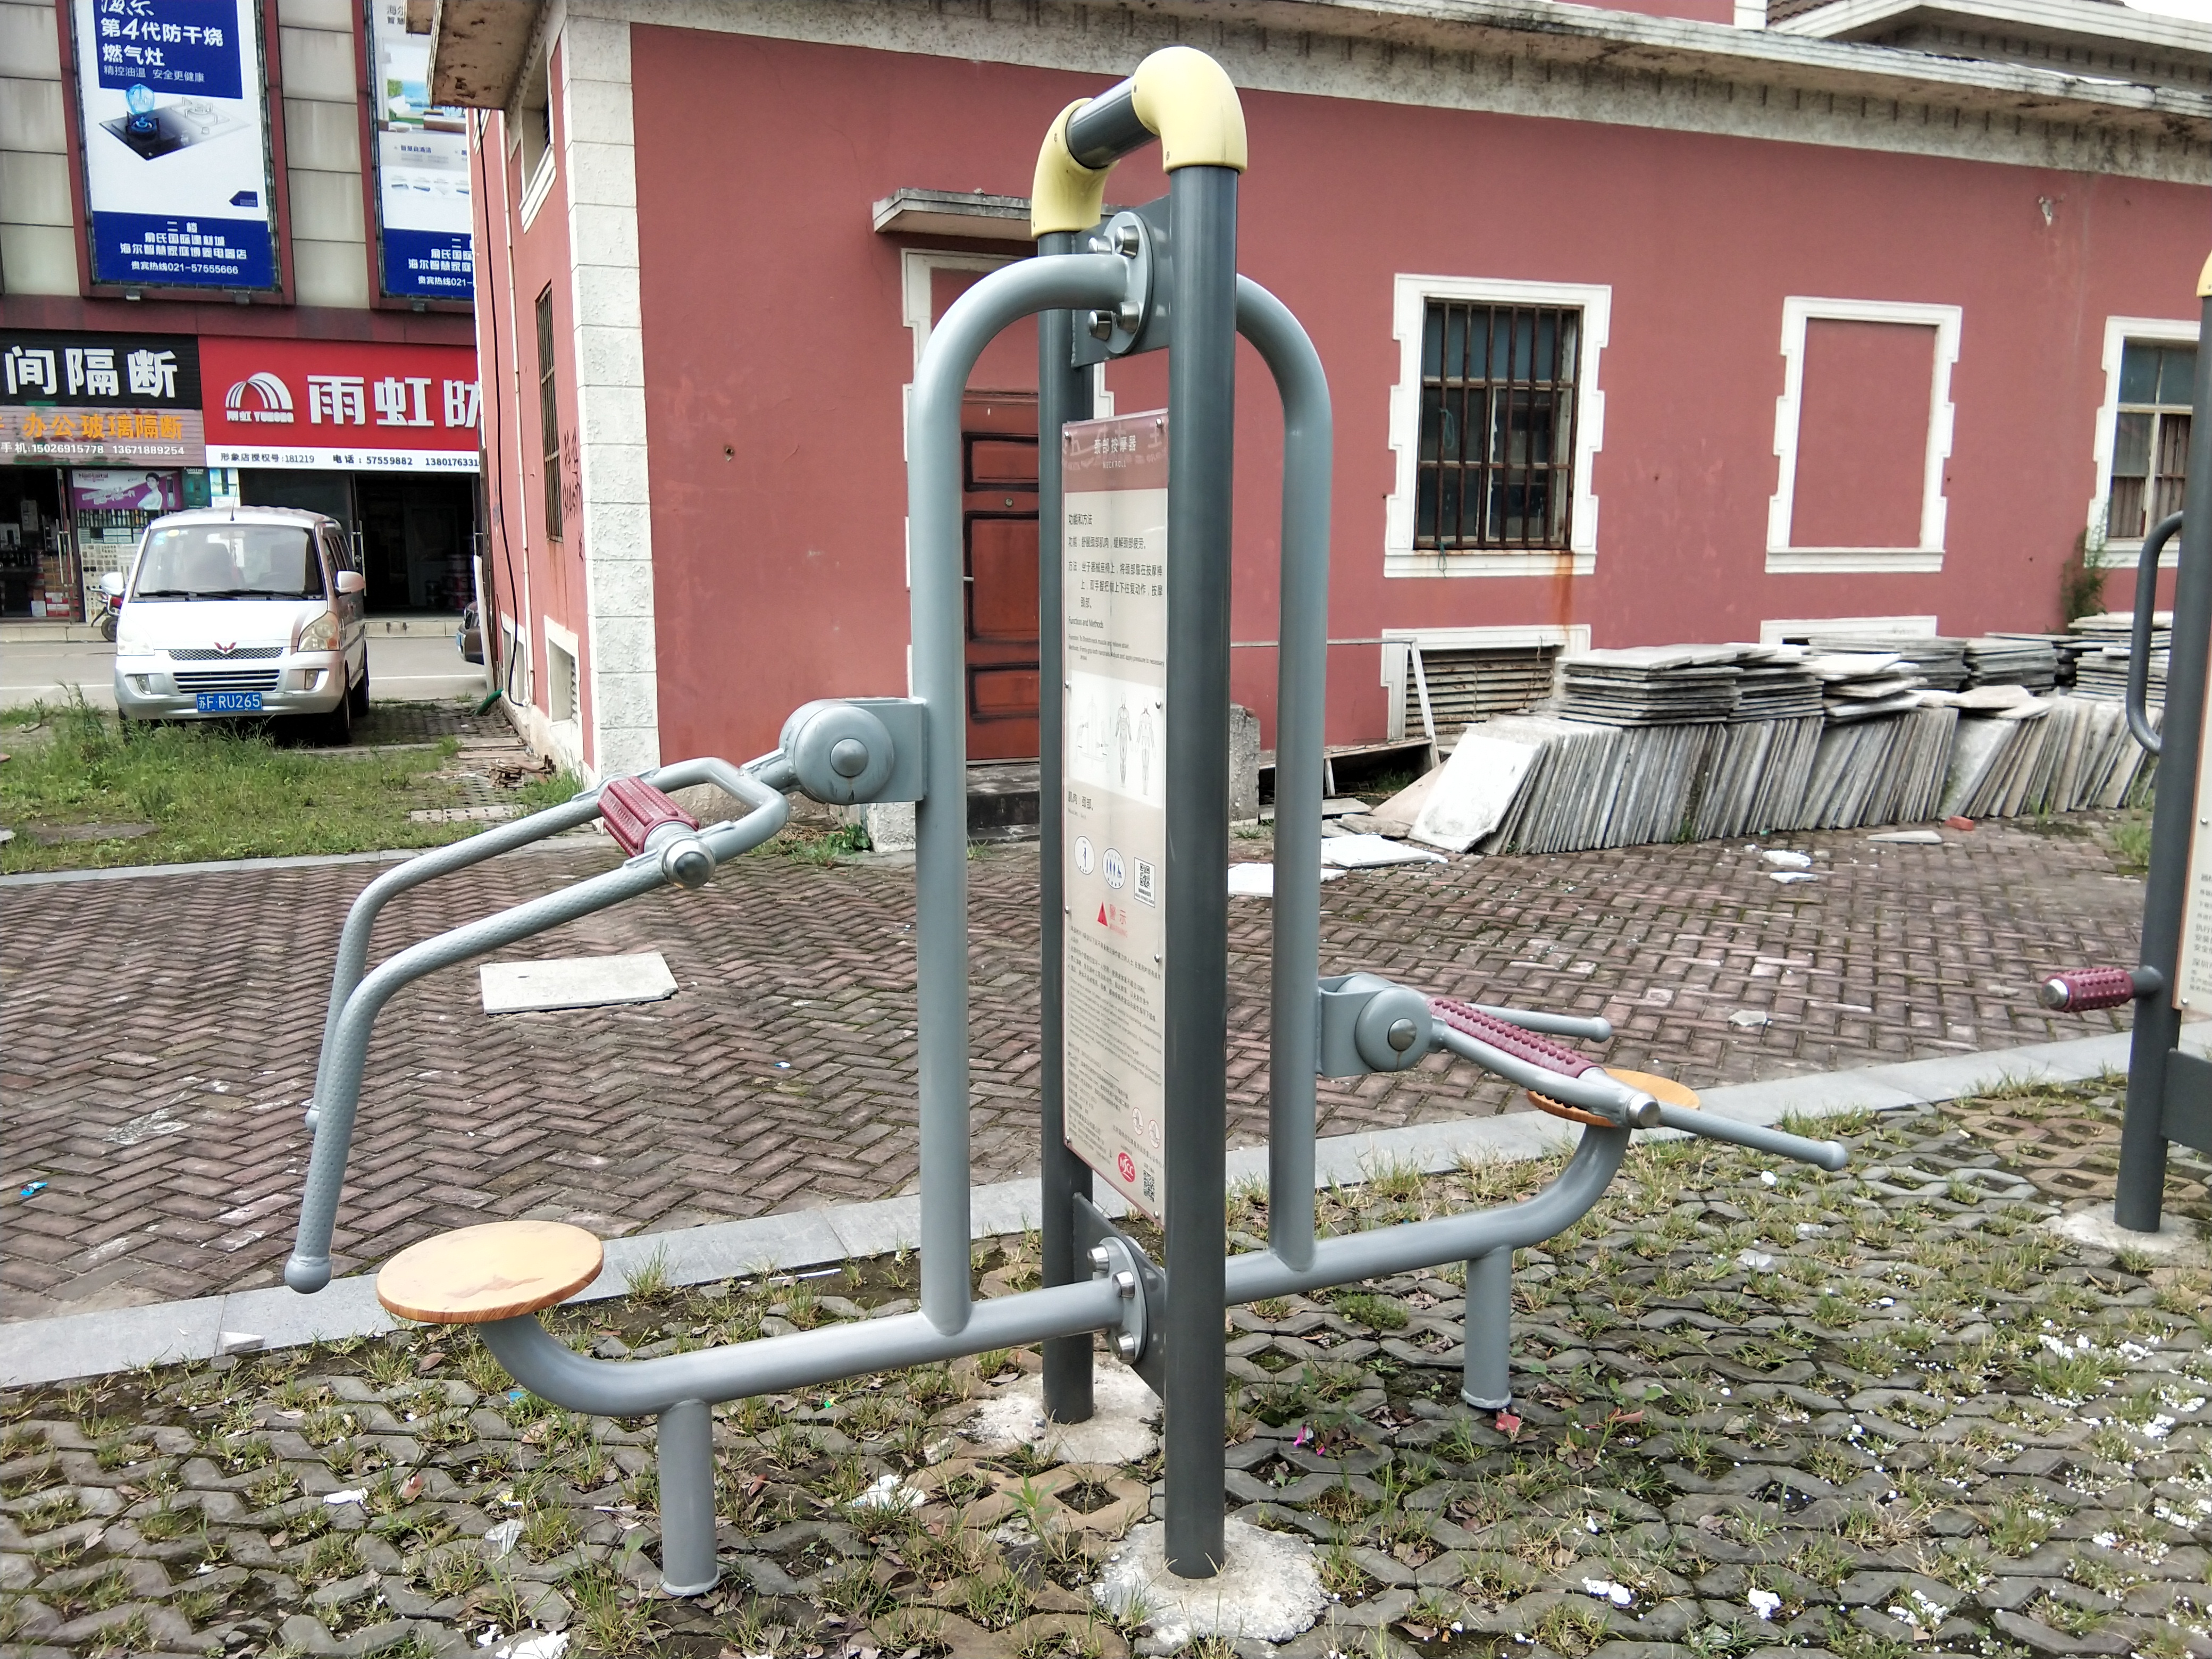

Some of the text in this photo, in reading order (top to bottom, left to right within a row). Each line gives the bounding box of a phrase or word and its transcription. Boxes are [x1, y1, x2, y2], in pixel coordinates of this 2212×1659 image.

[100, 17, 223, 47] 第4代防干烧
[102, 43, 165, 67] 燃气灶
[103, 65, 205, 82] 精控油温 安全更健康
[4, 345, 178, 398] 间隔断
[22, 413, 184, 440] 办公玻璃隔断
[112, 445, 185, 455] 13671889254
[1094, 435, 1136, 455] 颈部按摩器
[1068, 513, 1093, 525] 功能和方法
